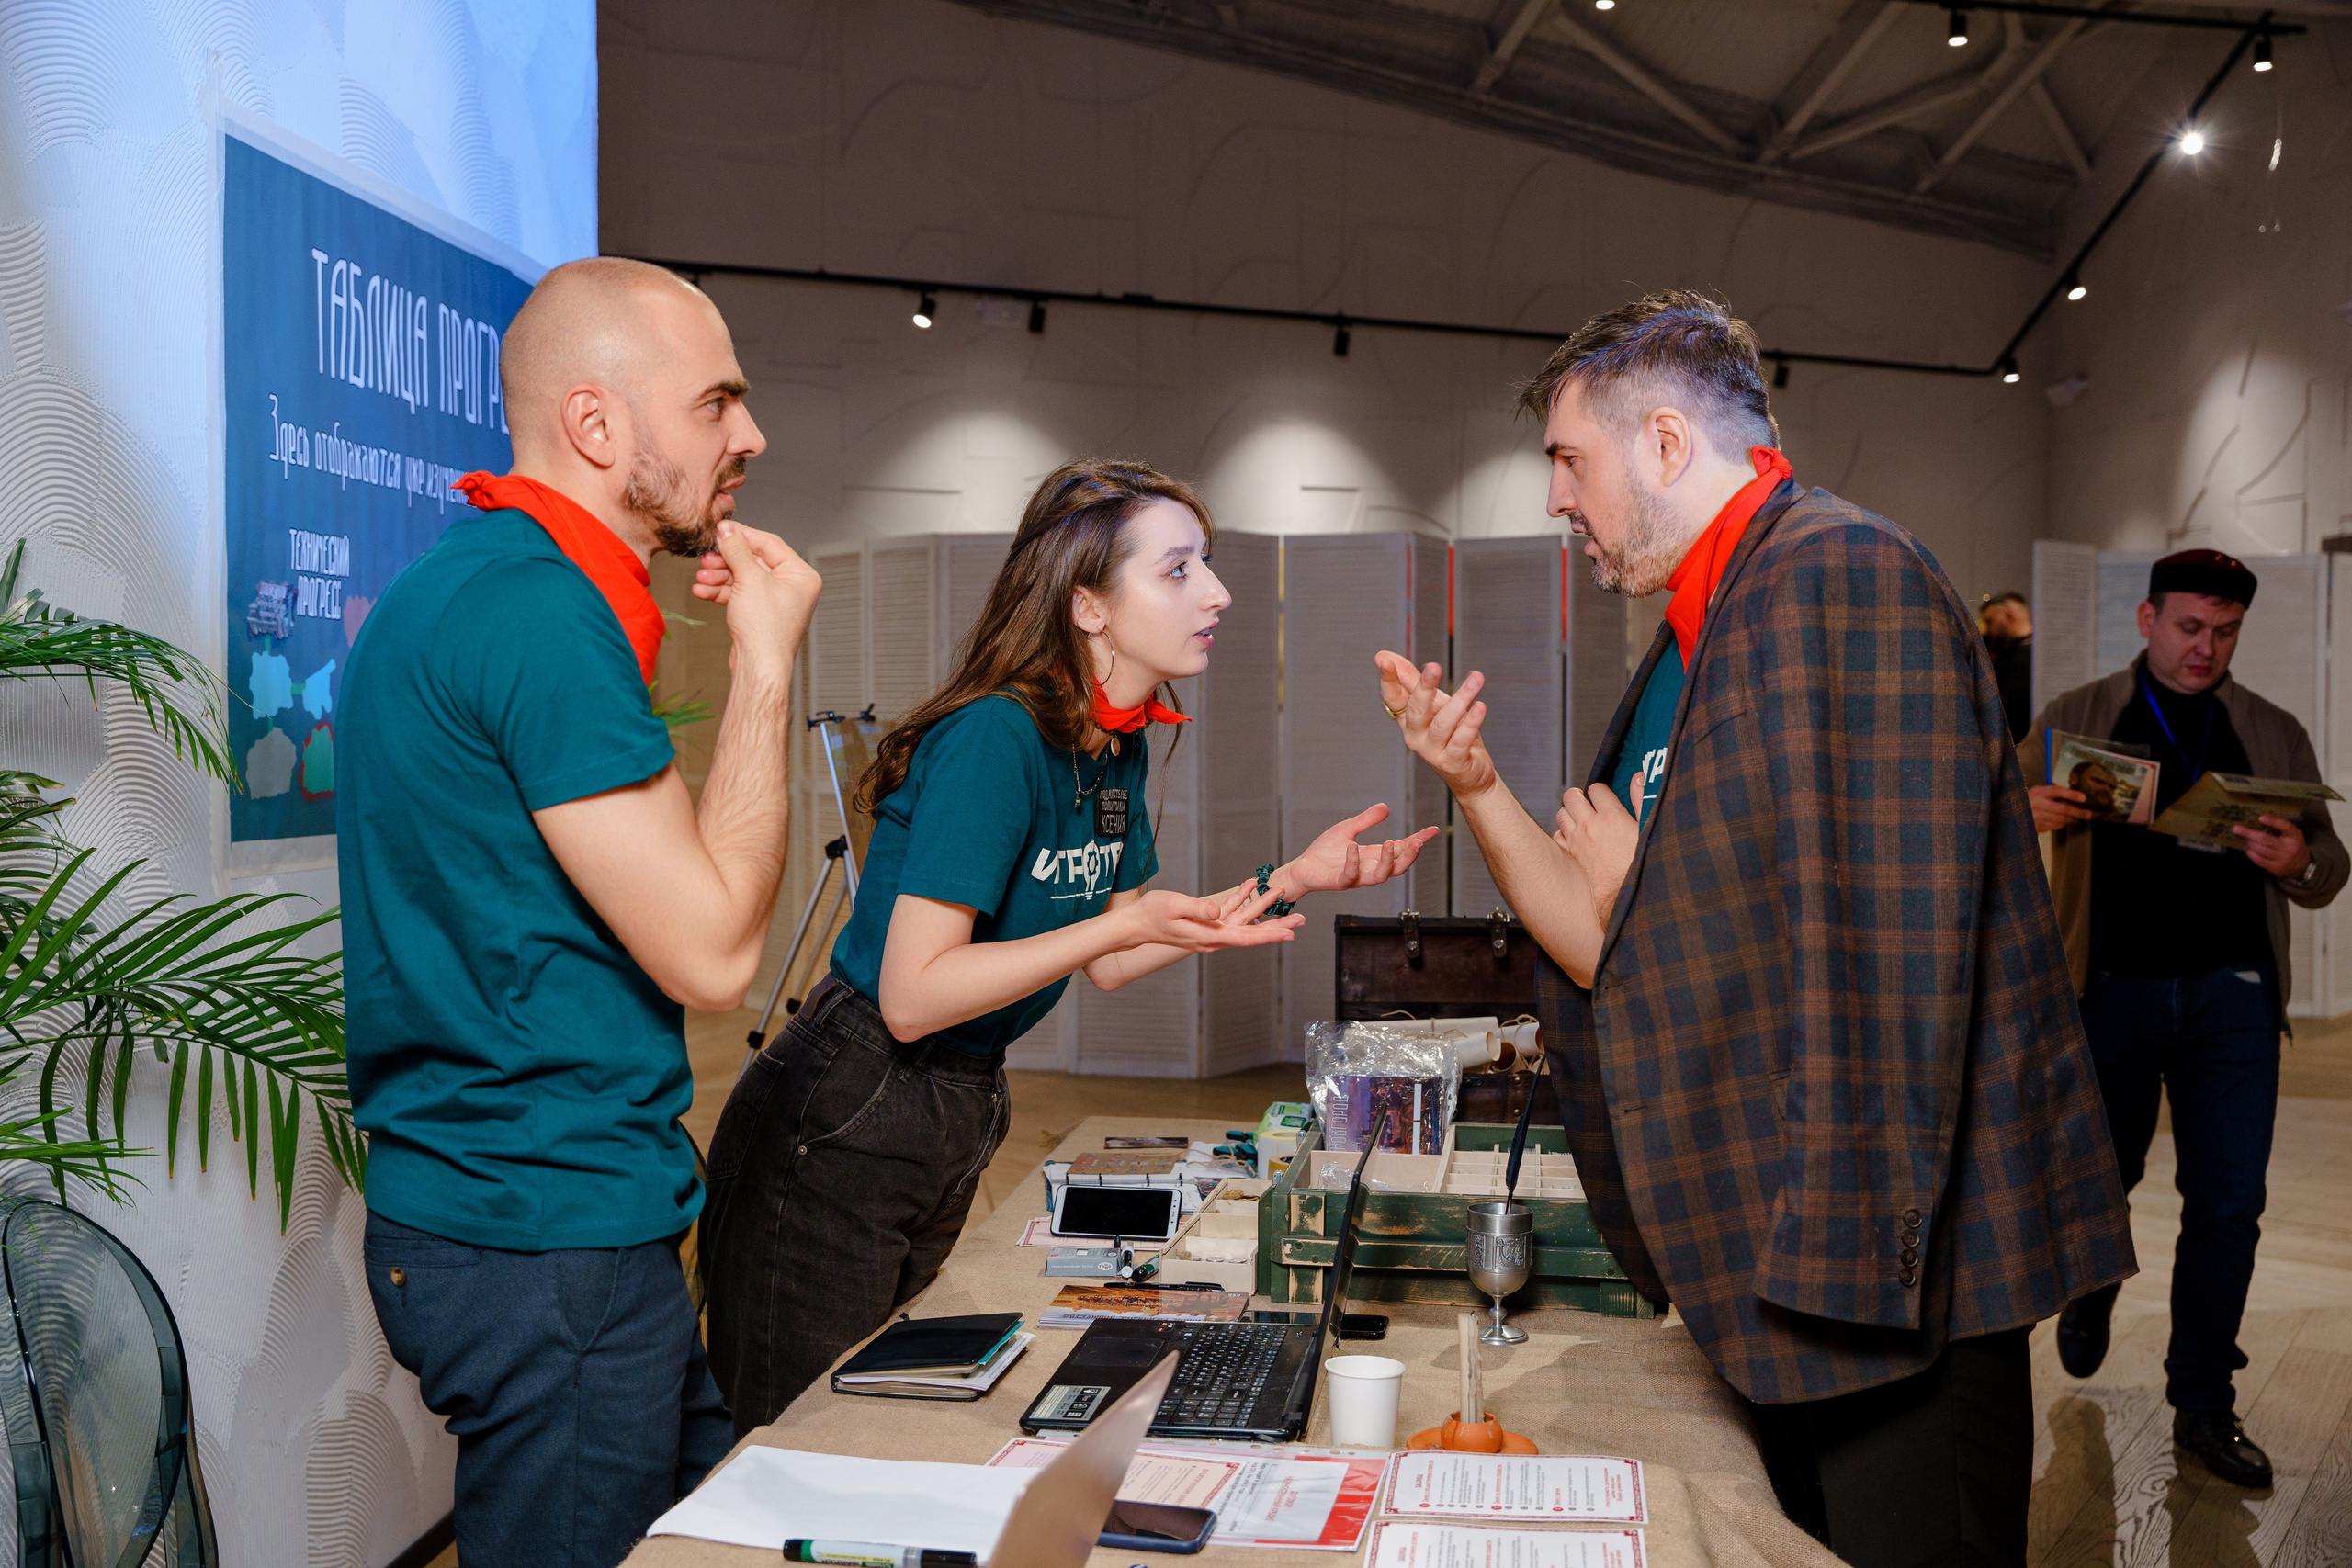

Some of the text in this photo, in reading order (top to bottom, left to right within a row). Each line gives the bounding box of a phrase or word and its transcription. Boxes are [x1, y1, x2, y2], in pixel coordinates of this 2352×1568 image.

[311, 247, 429, 415] ТАБЛИЦА
[268, 392, 310, 480] Здесь
[314, 421, 401, 491] отображаются
[405, 456, 424, 508] уже
[289, 527, 350, 577] ТЕХНИЧЕСКИЙ
[296, 574, 342, 620] ПРОГРЕСС
[1102, 814, 1125, 834] КСЕНИЯ
[1330, 1095, 1349, 1150] НОВГОРОД
